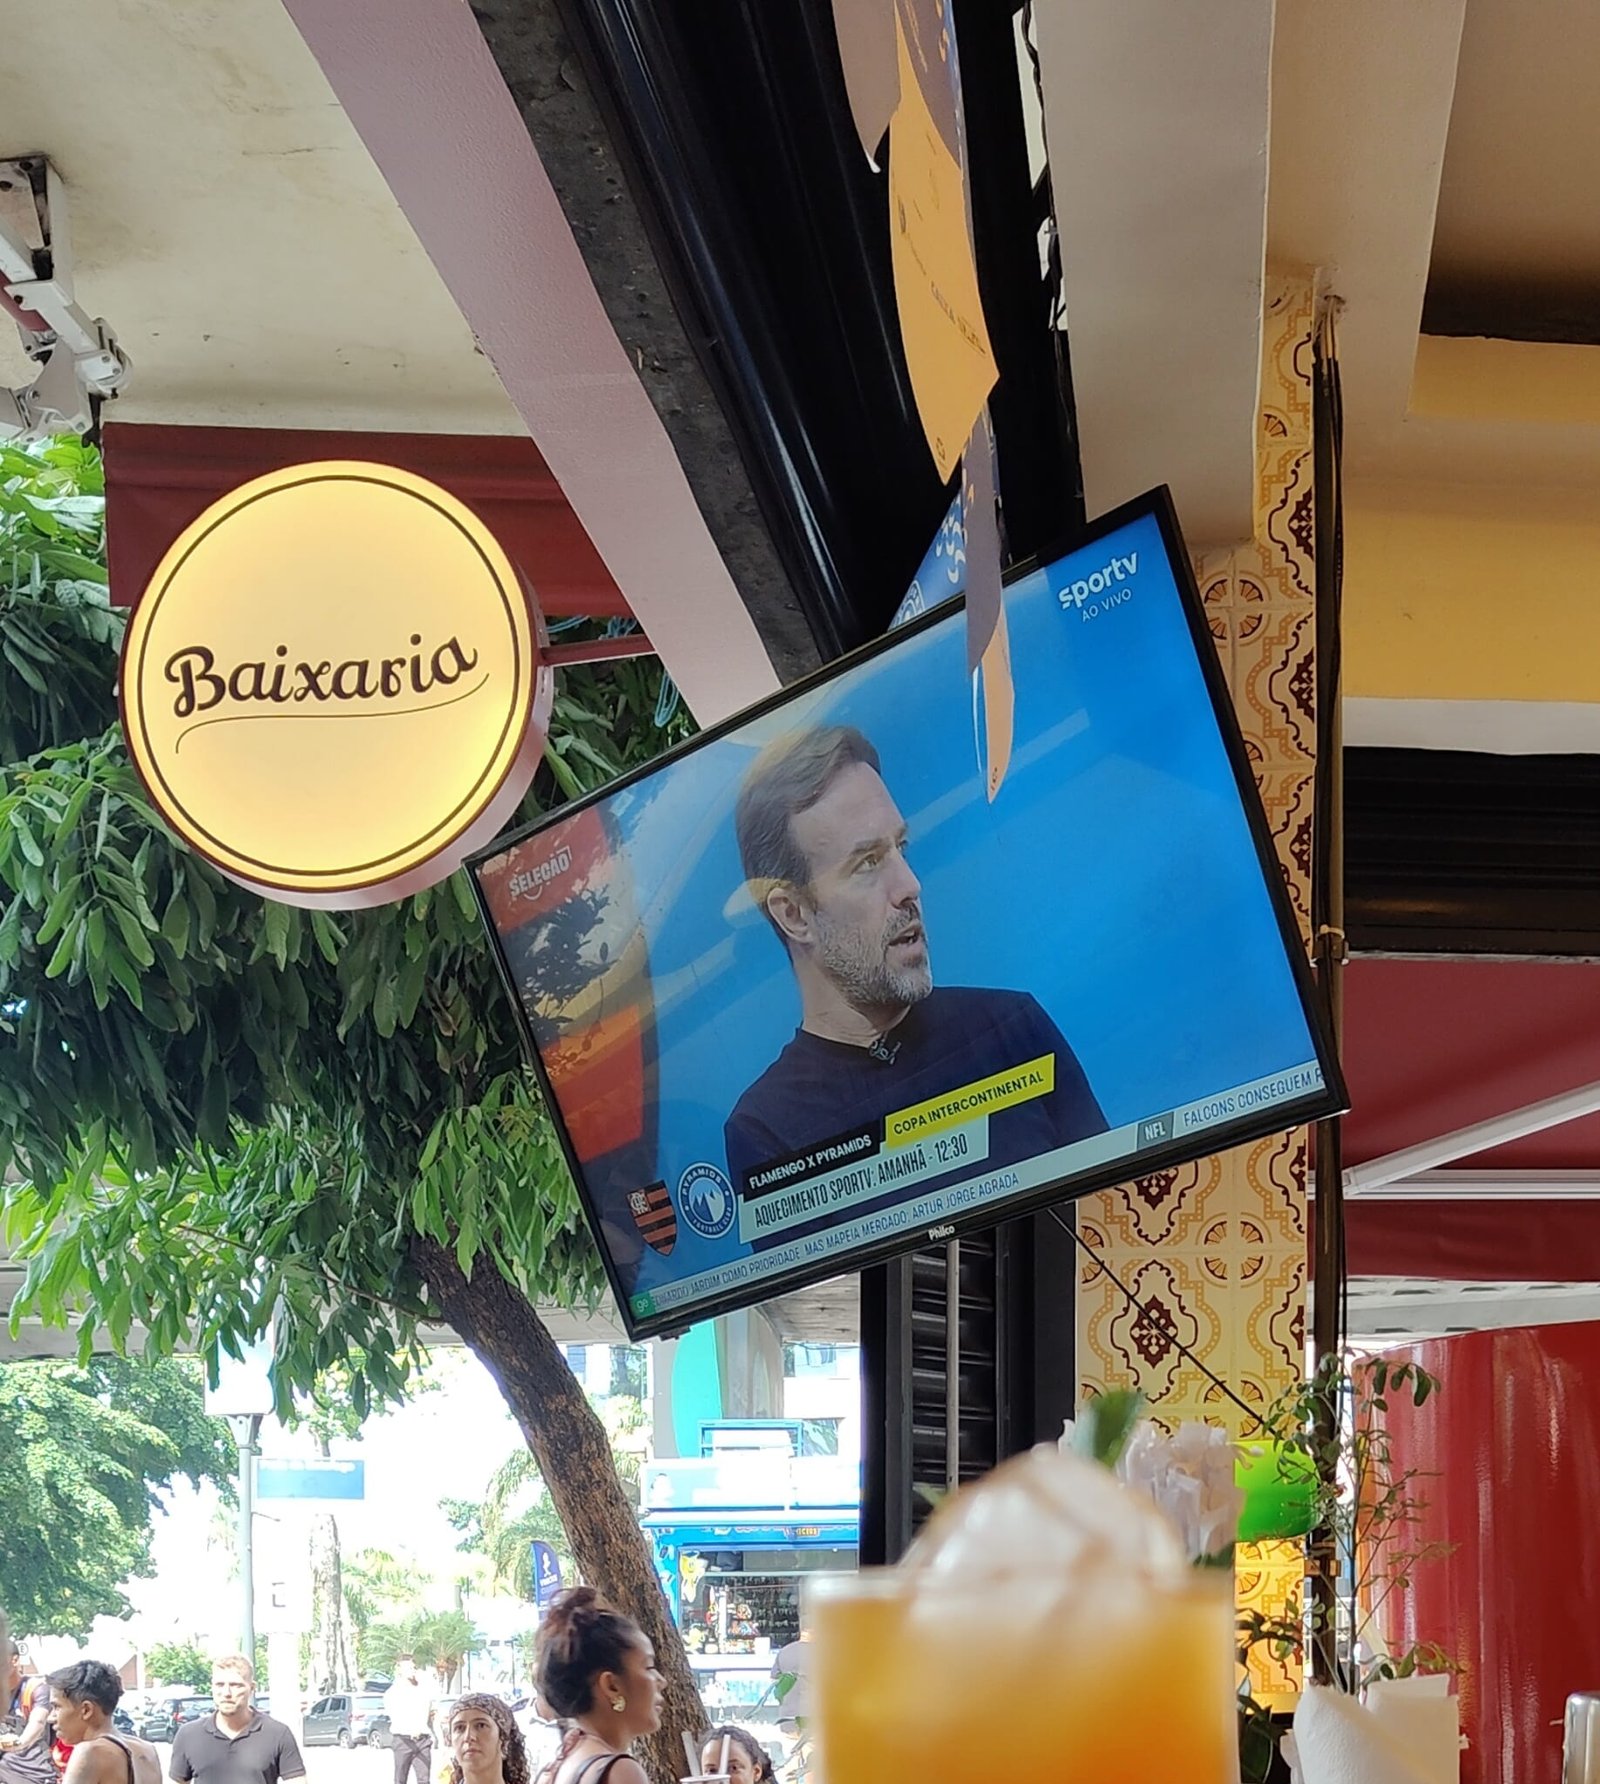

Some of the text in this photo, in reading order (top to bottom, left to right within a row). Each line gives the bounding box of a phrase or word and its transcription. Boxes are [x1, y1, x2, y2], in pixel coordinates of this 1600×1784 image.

[1058, 552, 1137, 609] sportv
[1082, 588, 1132, 622] AO VIVO
[164, 633, 478, 718] Baixaria
[893, 1071, 1044, 1135] COPA INTERCONTINENTAL
[1144, 1121, 1167, 1142] NFL
[1183, 1097, 1236, 1127] FALCONS
[1236, 1071, 1312, 1109] CONSEGUEM
[682, 1168, 722, 1196] PYRAMIDS
[749, 1134, 872, 1190] FLAMENGO X PYRAMIDS
[754, 1183, 830, 1229] AQUECIMENTO
[828, 1167, 878, 1202] SPORTV:
[877, 1143, 928, 1185] AMANHÃ
[934, 1133, 969, 1164] 12:30
[803, 1239, 825, 1256] MAS
[825, 1225, 861, 1250] MAPEIA
[911, 1197, 944, 1220] ARTUR
[945, 1186, 976, 1210] JORGE
[978, 1171, 1020, 1198] AGRADA
[927, 1225, 956, 1241] Philco
